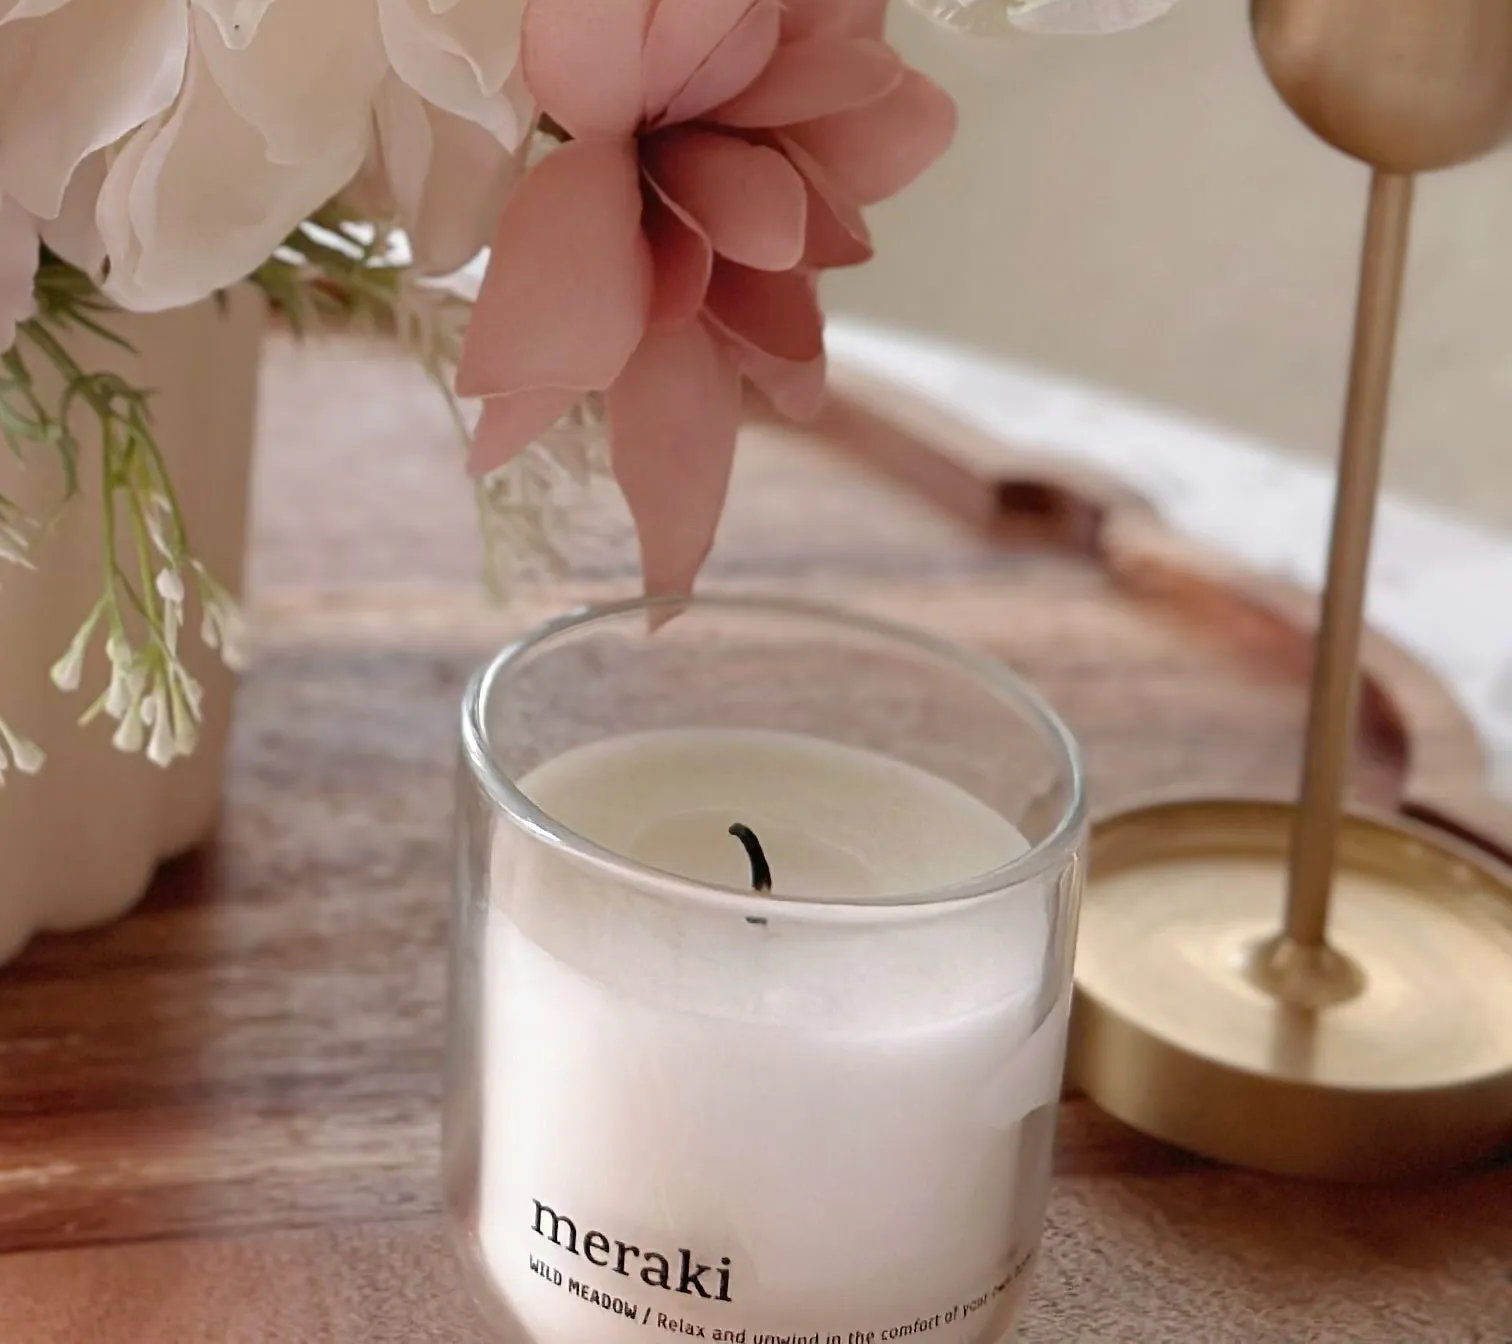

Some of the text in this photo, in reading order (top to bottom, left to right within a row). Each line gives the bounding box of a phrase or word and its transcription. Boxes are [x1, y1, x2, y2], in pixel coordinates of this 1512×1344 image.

[529, 1253, 562, 1286] WILD
[568, 1277, 638, 1320] MEADOW
[657, 1312, 705, 1338] Relax
[712, 1328, 746, 1344] and
[881, 1315, 939, 1341] comfort
[531, 1198, 732, 1302] meraki
